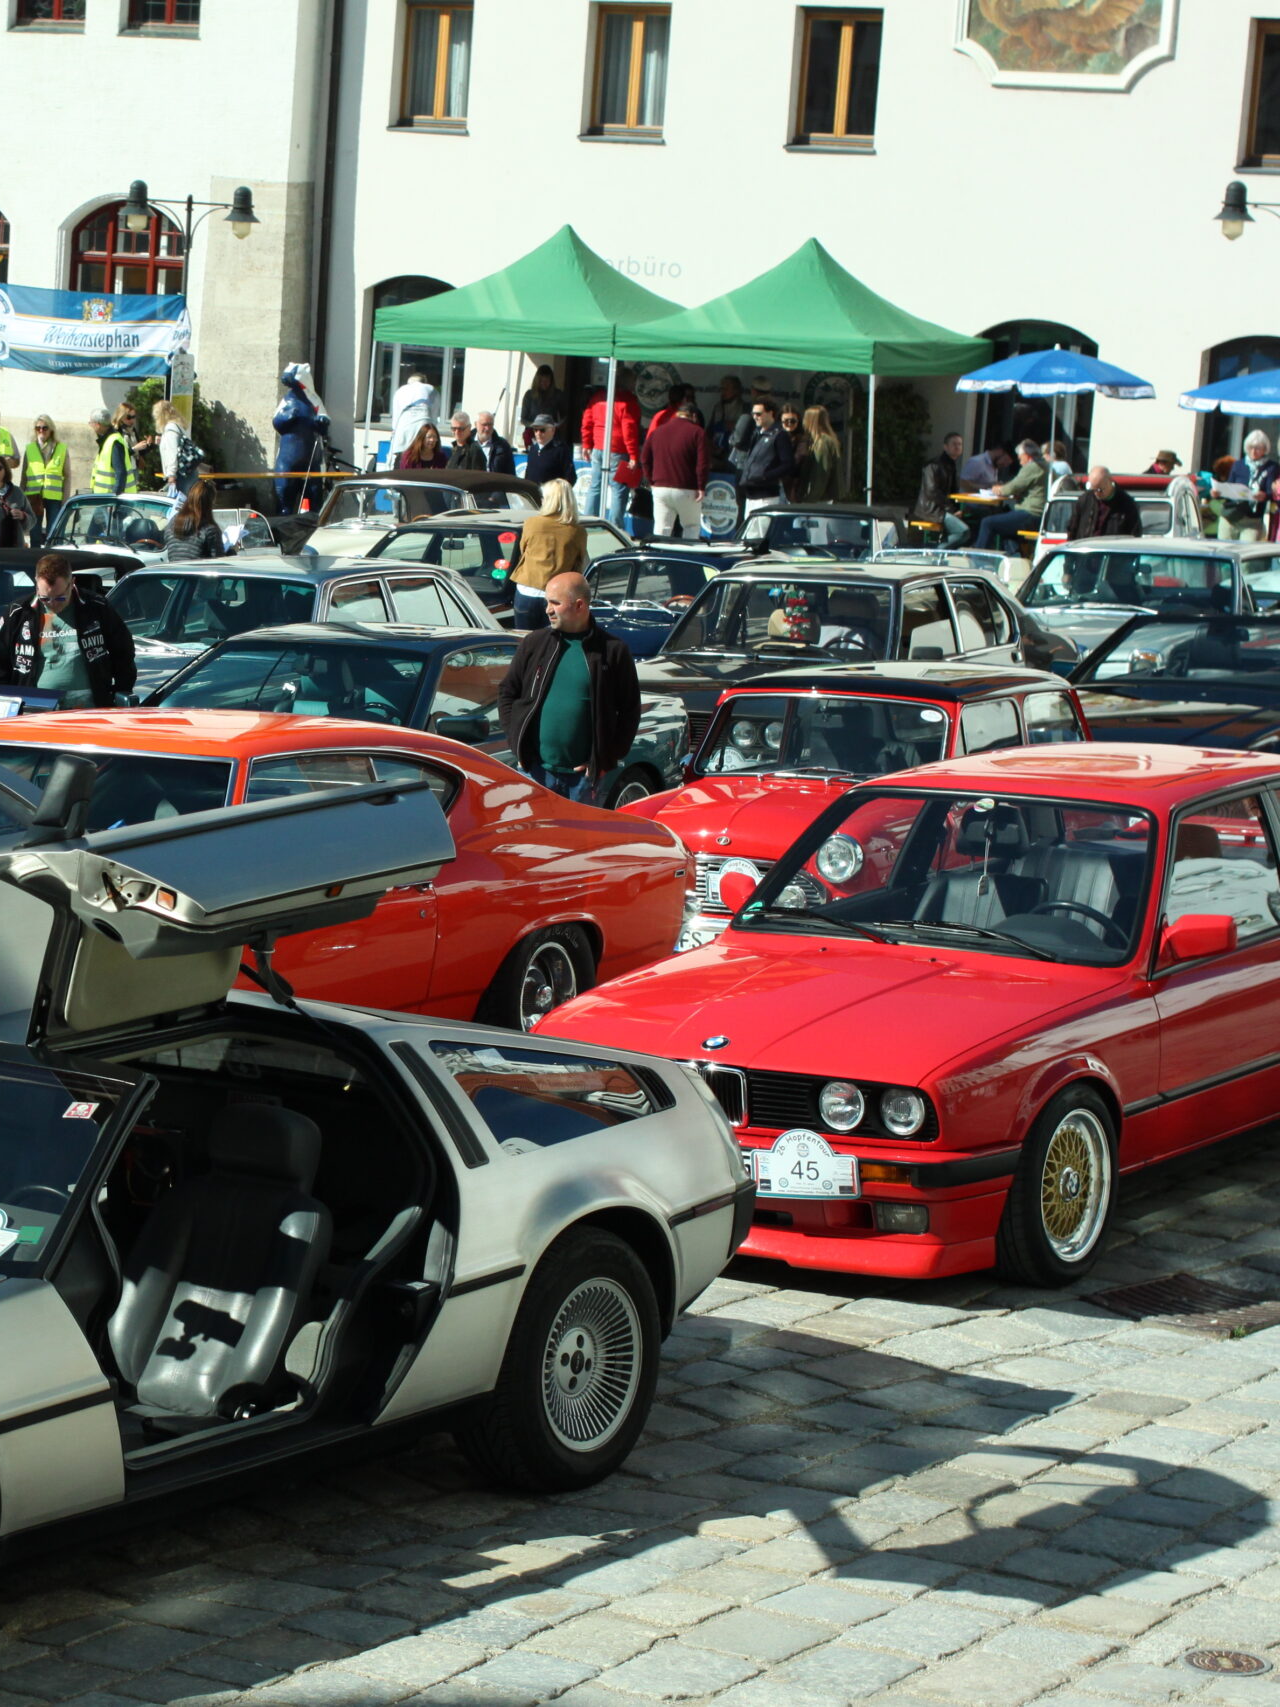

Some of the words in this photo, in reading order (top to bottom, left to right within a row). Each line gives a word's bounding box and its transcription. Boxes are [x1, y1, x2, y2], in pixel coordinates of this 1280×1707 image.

[43, 325, 140, 351] Weihenstephan
[81, 634, 104, 649] DAVID
[786, 1133, 831, 1158] Hopfentour
[790, 1160, 820, 1181] 45
